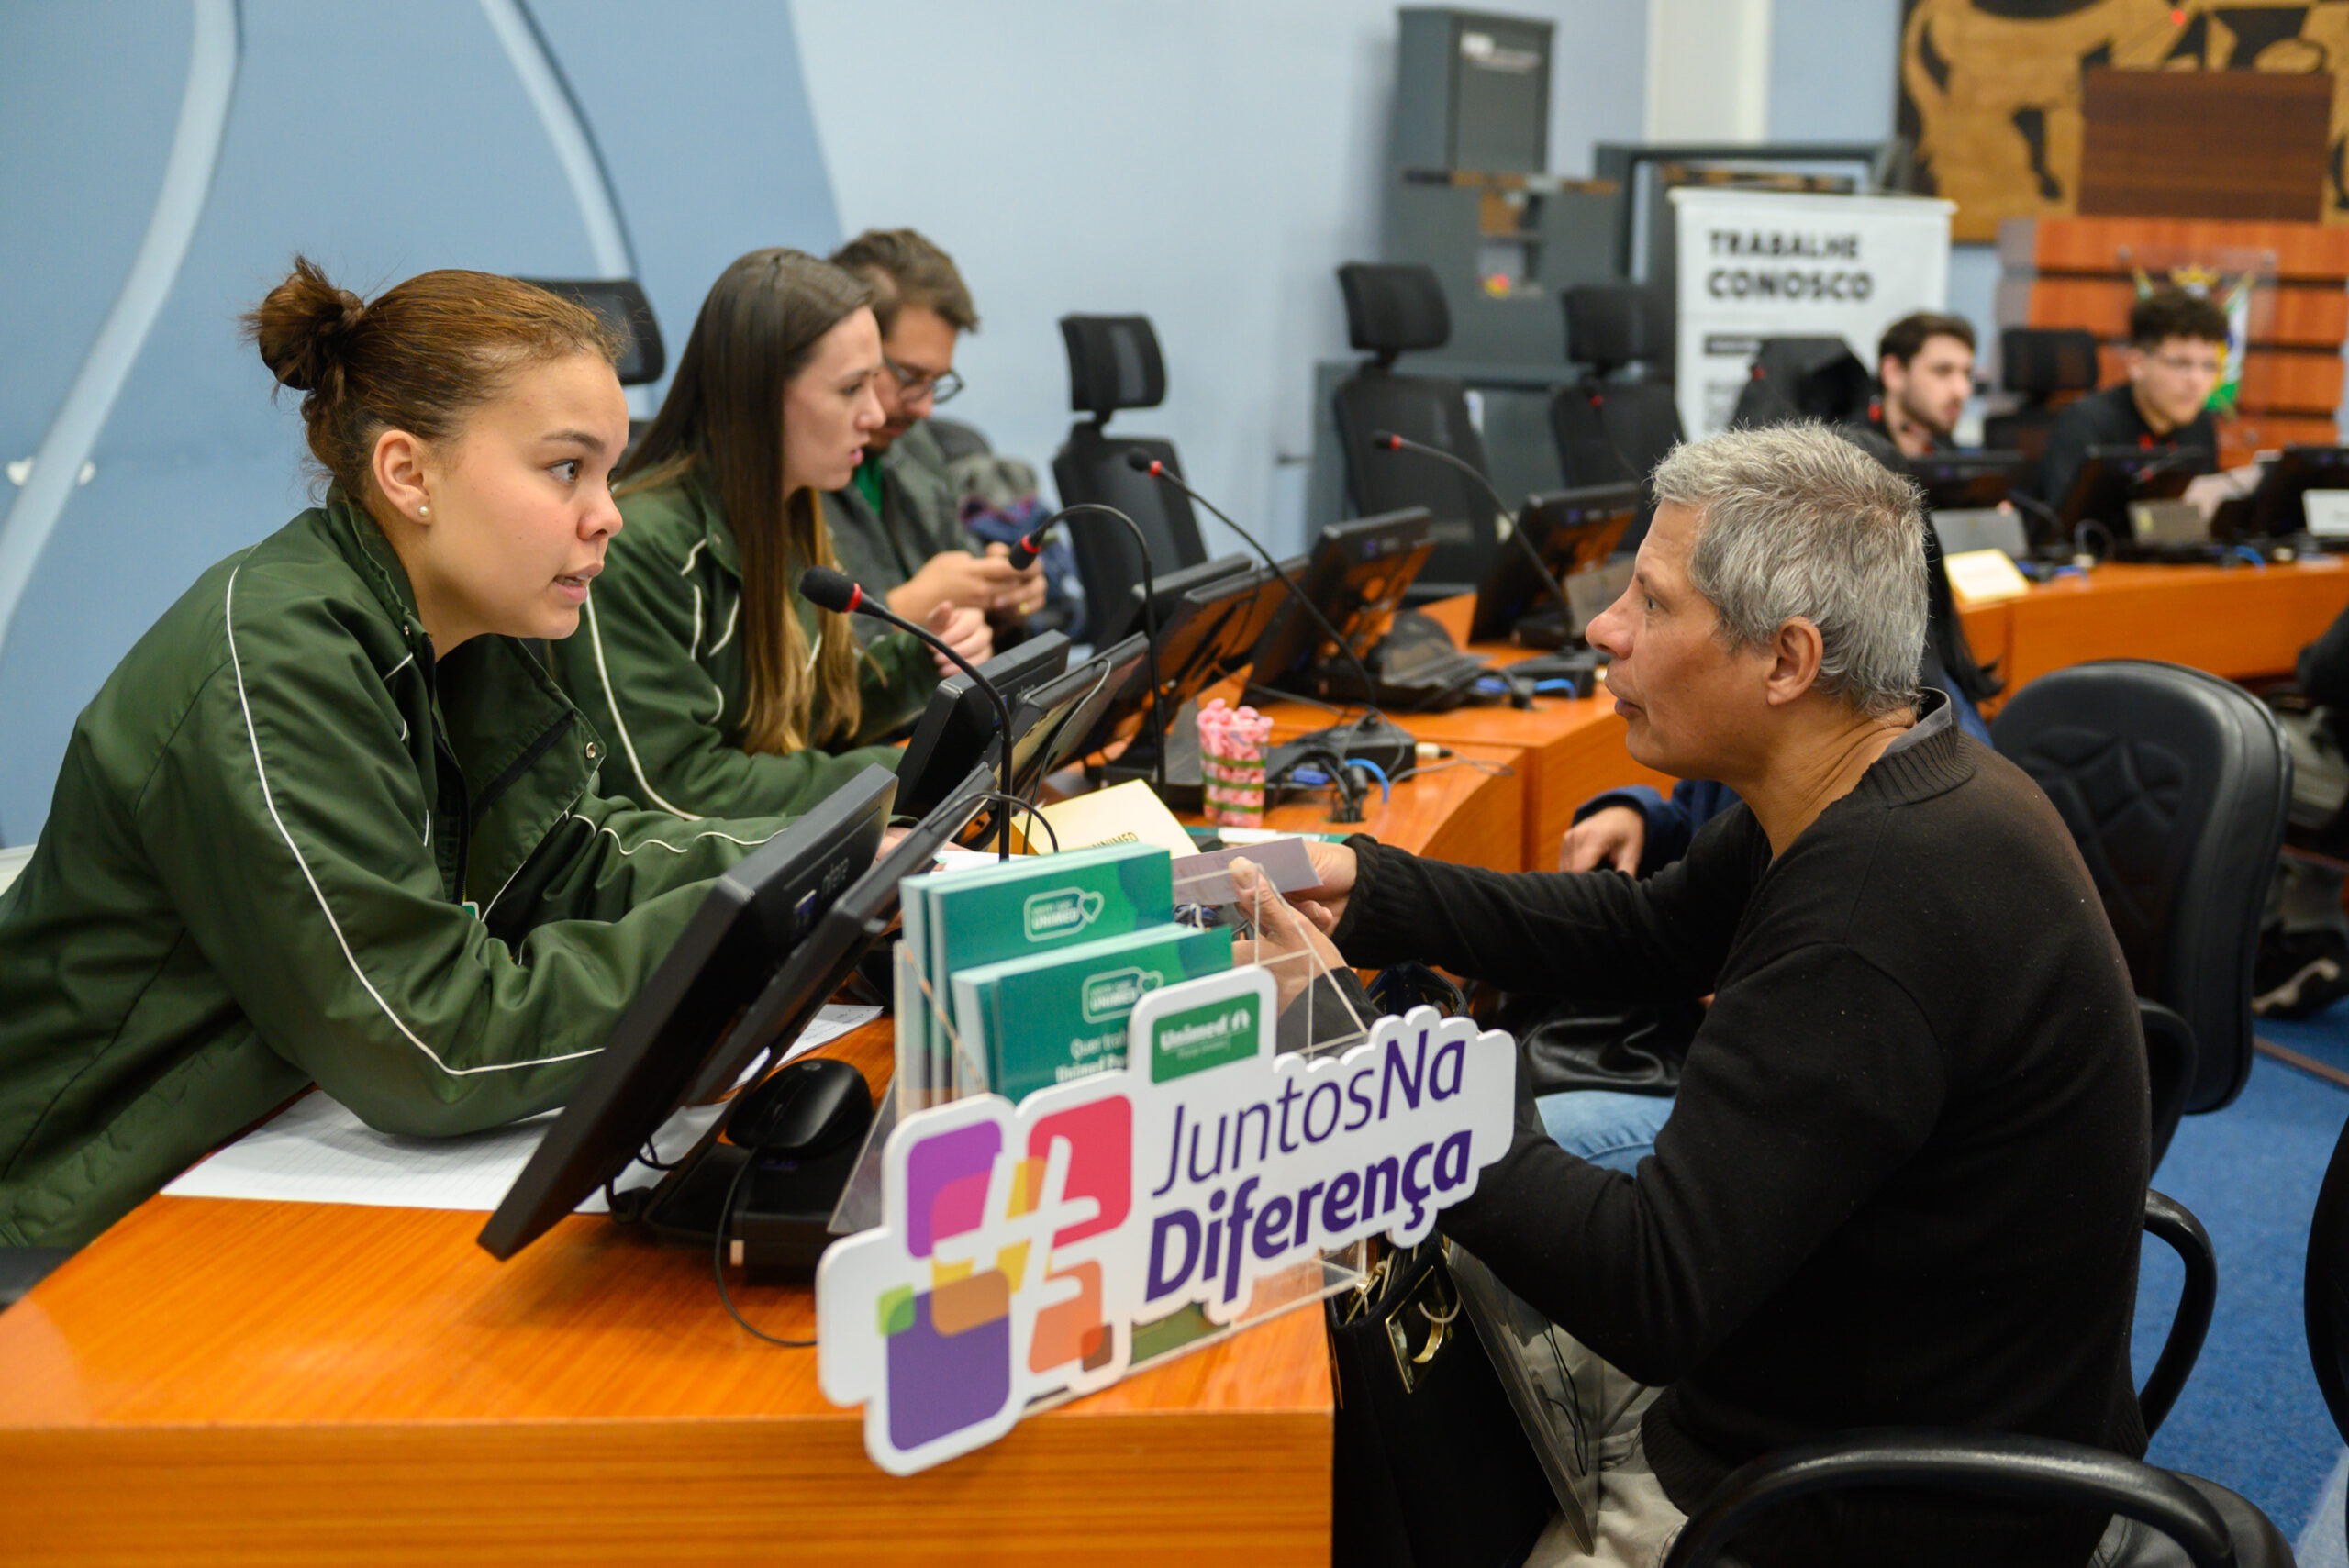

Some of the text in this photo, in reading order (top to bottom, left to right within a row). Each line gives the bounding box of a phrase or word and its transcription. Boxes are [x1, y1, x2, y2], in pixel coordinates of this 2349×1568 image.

[1709, 230, 1859, 259] TRABALHE
[1709, 269, 1872, 300] CONOSCO
[1160, 1013, 1228, 1051] Unimed
[1152, 1029, 1465, 1198] JuntosNa
[1145, 1129, 1472, 1304] Diferença
